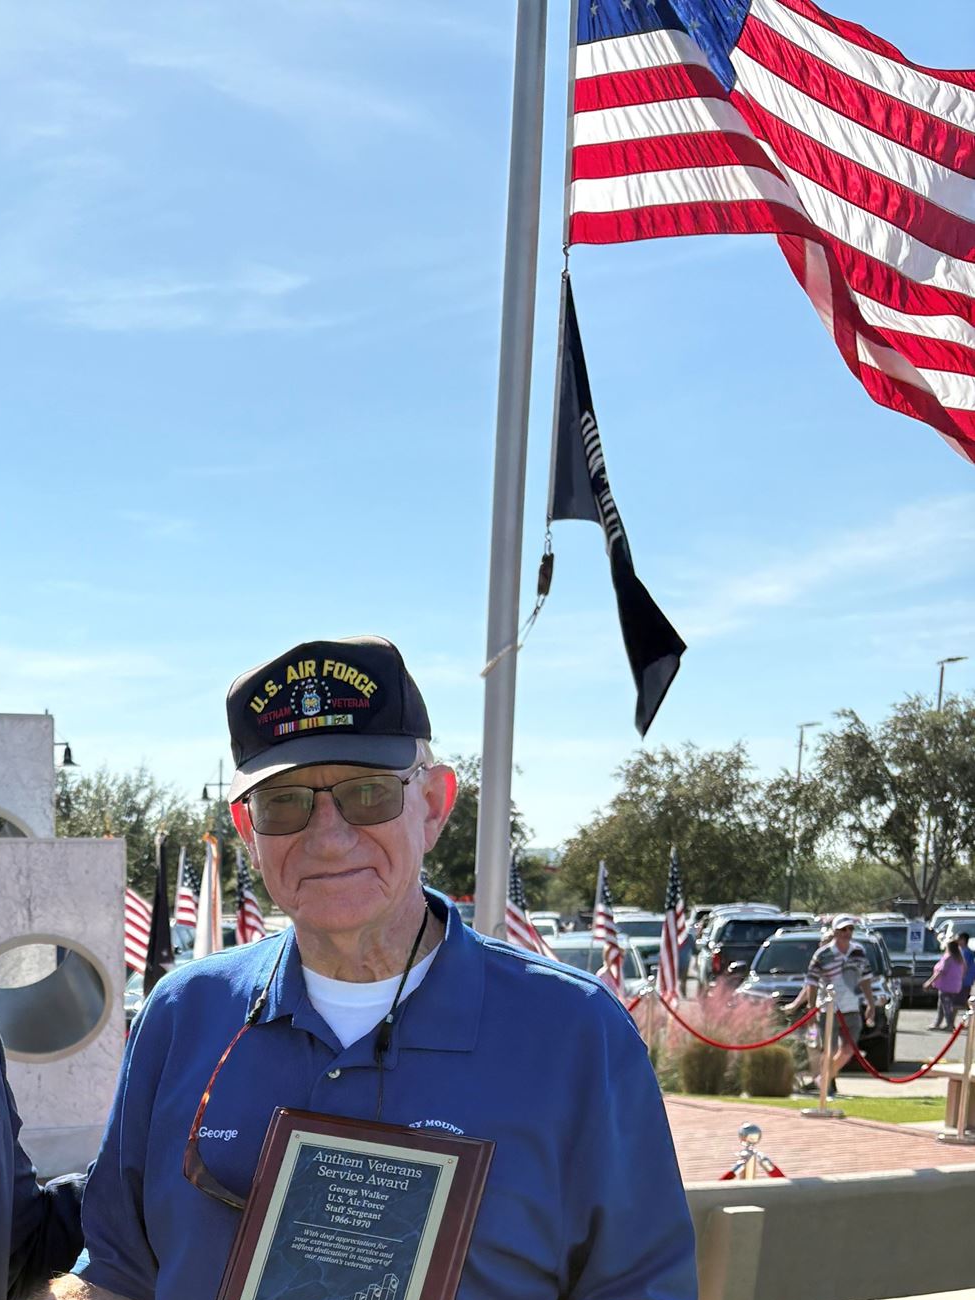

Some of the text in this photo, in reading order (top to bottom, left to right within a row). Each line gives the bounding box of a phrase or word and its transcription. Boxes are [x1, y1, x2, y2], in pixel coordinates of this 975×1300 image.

[250, 659, 377, 713] U.S. AIR FORCE
[331, 698, 369, 708] VETERAN
[198, 1126, 238, 1141] George
[313, 1151, 422, 1178] Anthem Veterans
[317, 1165, 409, 1191] Service Award
[328, 1183, 389, 1200] George Walker
[327, 1193, 385, 1210] U.S. Air Force
[325, 1203, 381, 1220] Staff Sergeant
[330, 1214, 371, 1228] 1966-1970
